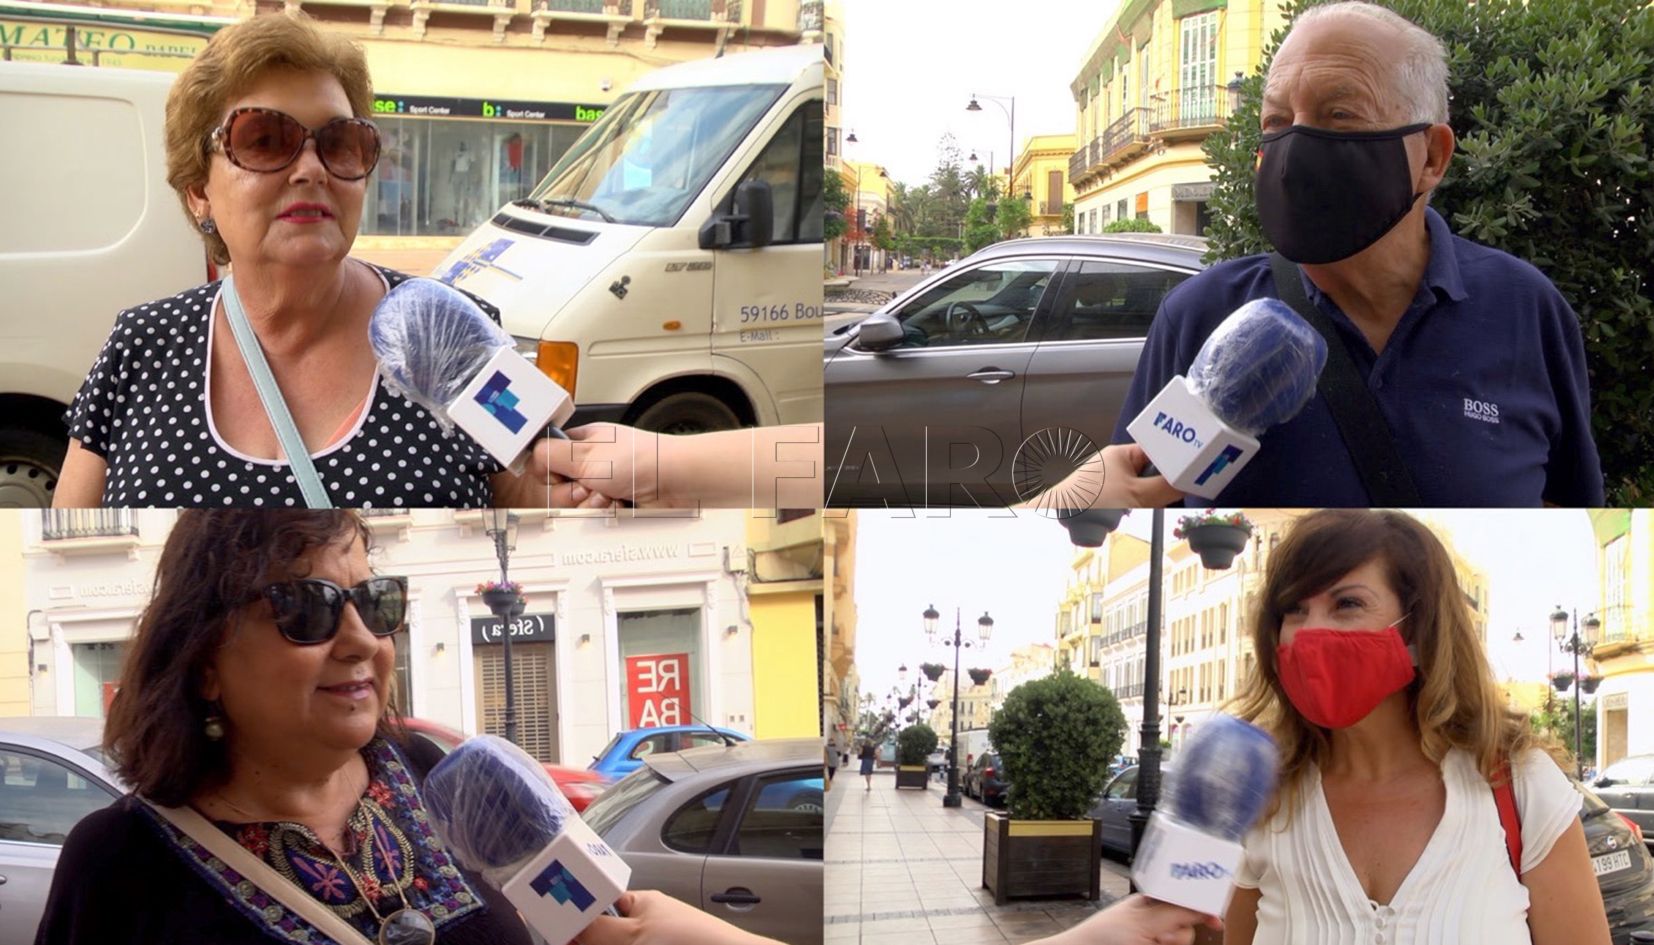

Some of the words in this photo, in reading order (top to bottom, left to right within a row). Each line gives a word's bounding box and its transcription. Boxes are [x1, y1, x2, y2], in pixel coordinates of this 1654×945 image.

[409, 105, 428, 115] Sport
[429, 106, 451, 115] Center
[506, 109, 525, 118] Sport
[525, 110, 546, 119] Center
[740, 305, 789, 323] 59166
[1463, 398, 1499, 417] BOSS
[1153, 411, 1196, 443] FARO
